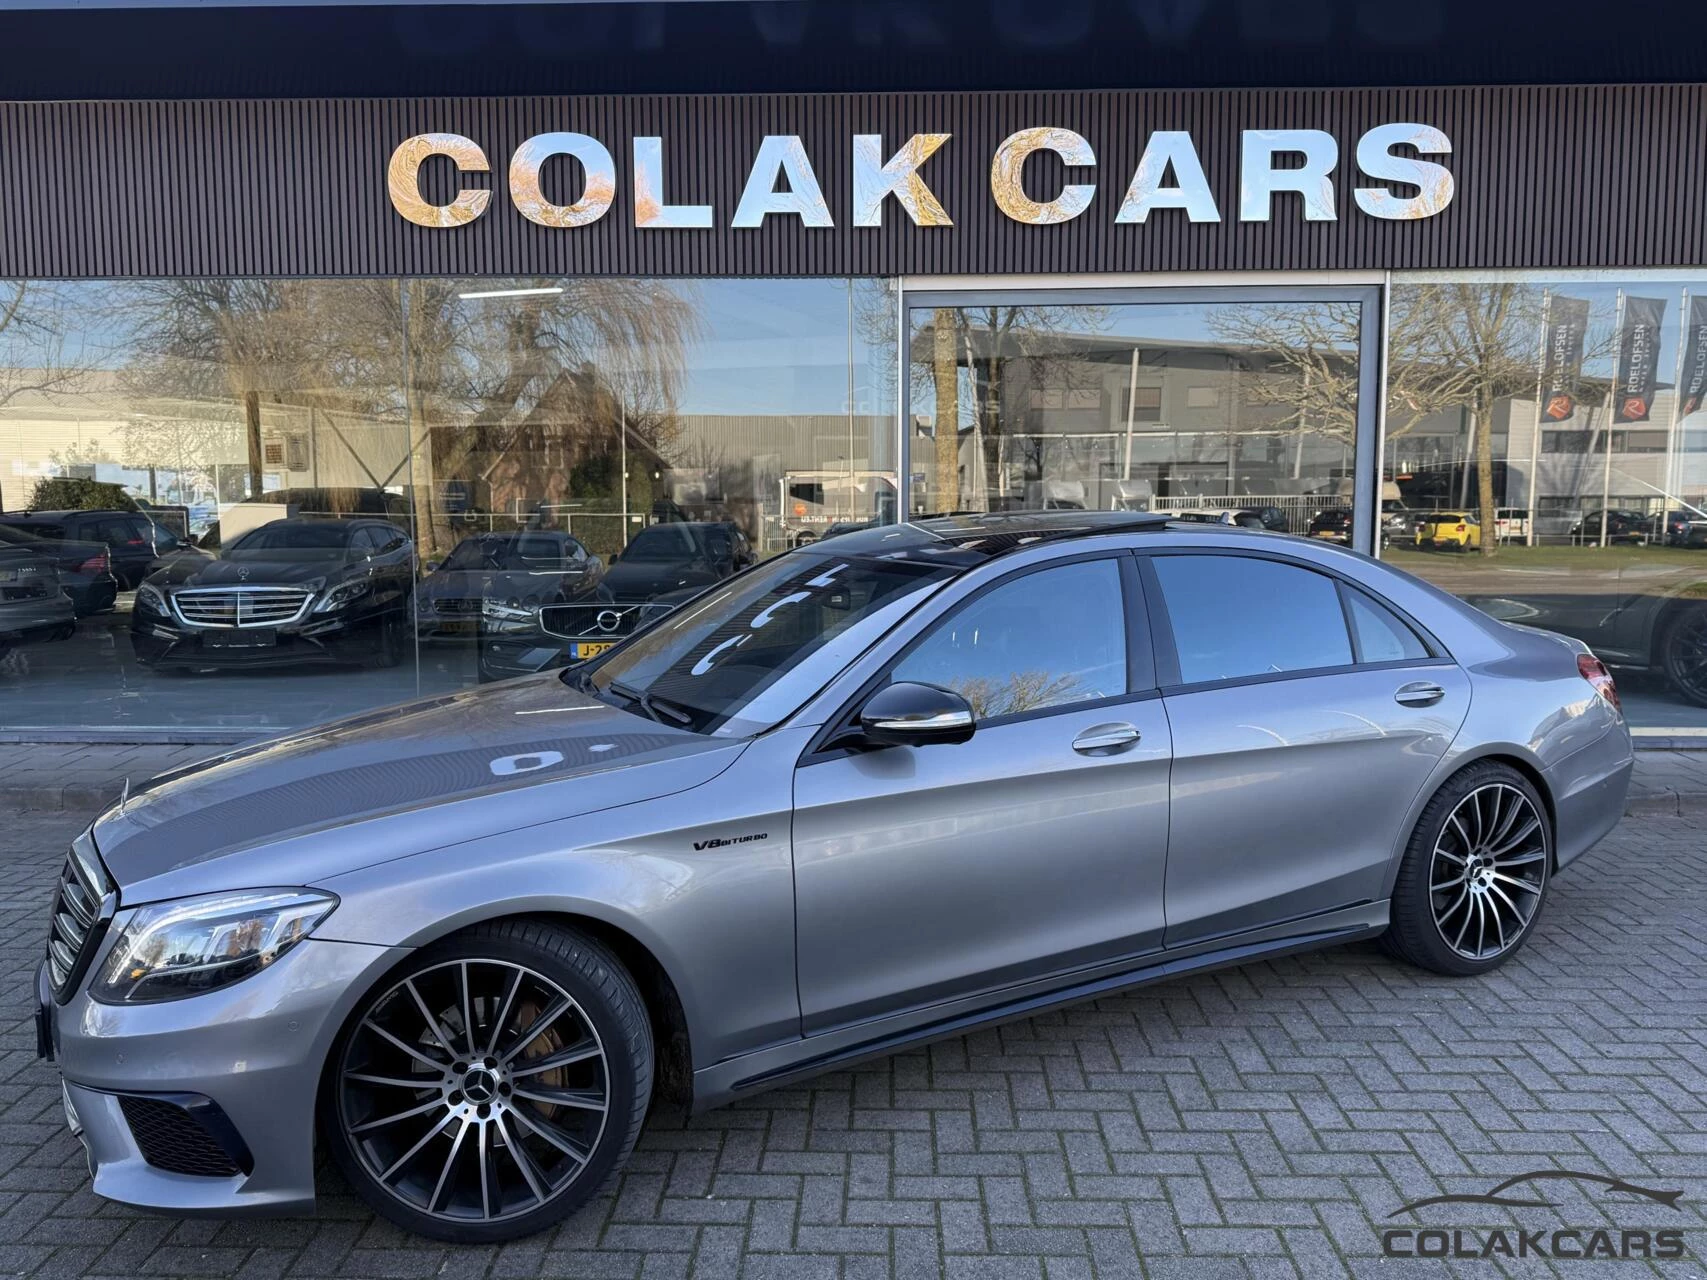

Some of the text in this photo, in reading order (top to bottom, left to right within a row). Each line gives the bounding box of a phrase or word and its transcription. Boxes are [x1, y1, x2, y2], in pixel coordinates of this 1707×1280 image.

[387, 122, 1455, 230] COLAK CARS
[1627, 324, 1645, 393] ROELOFSEN
